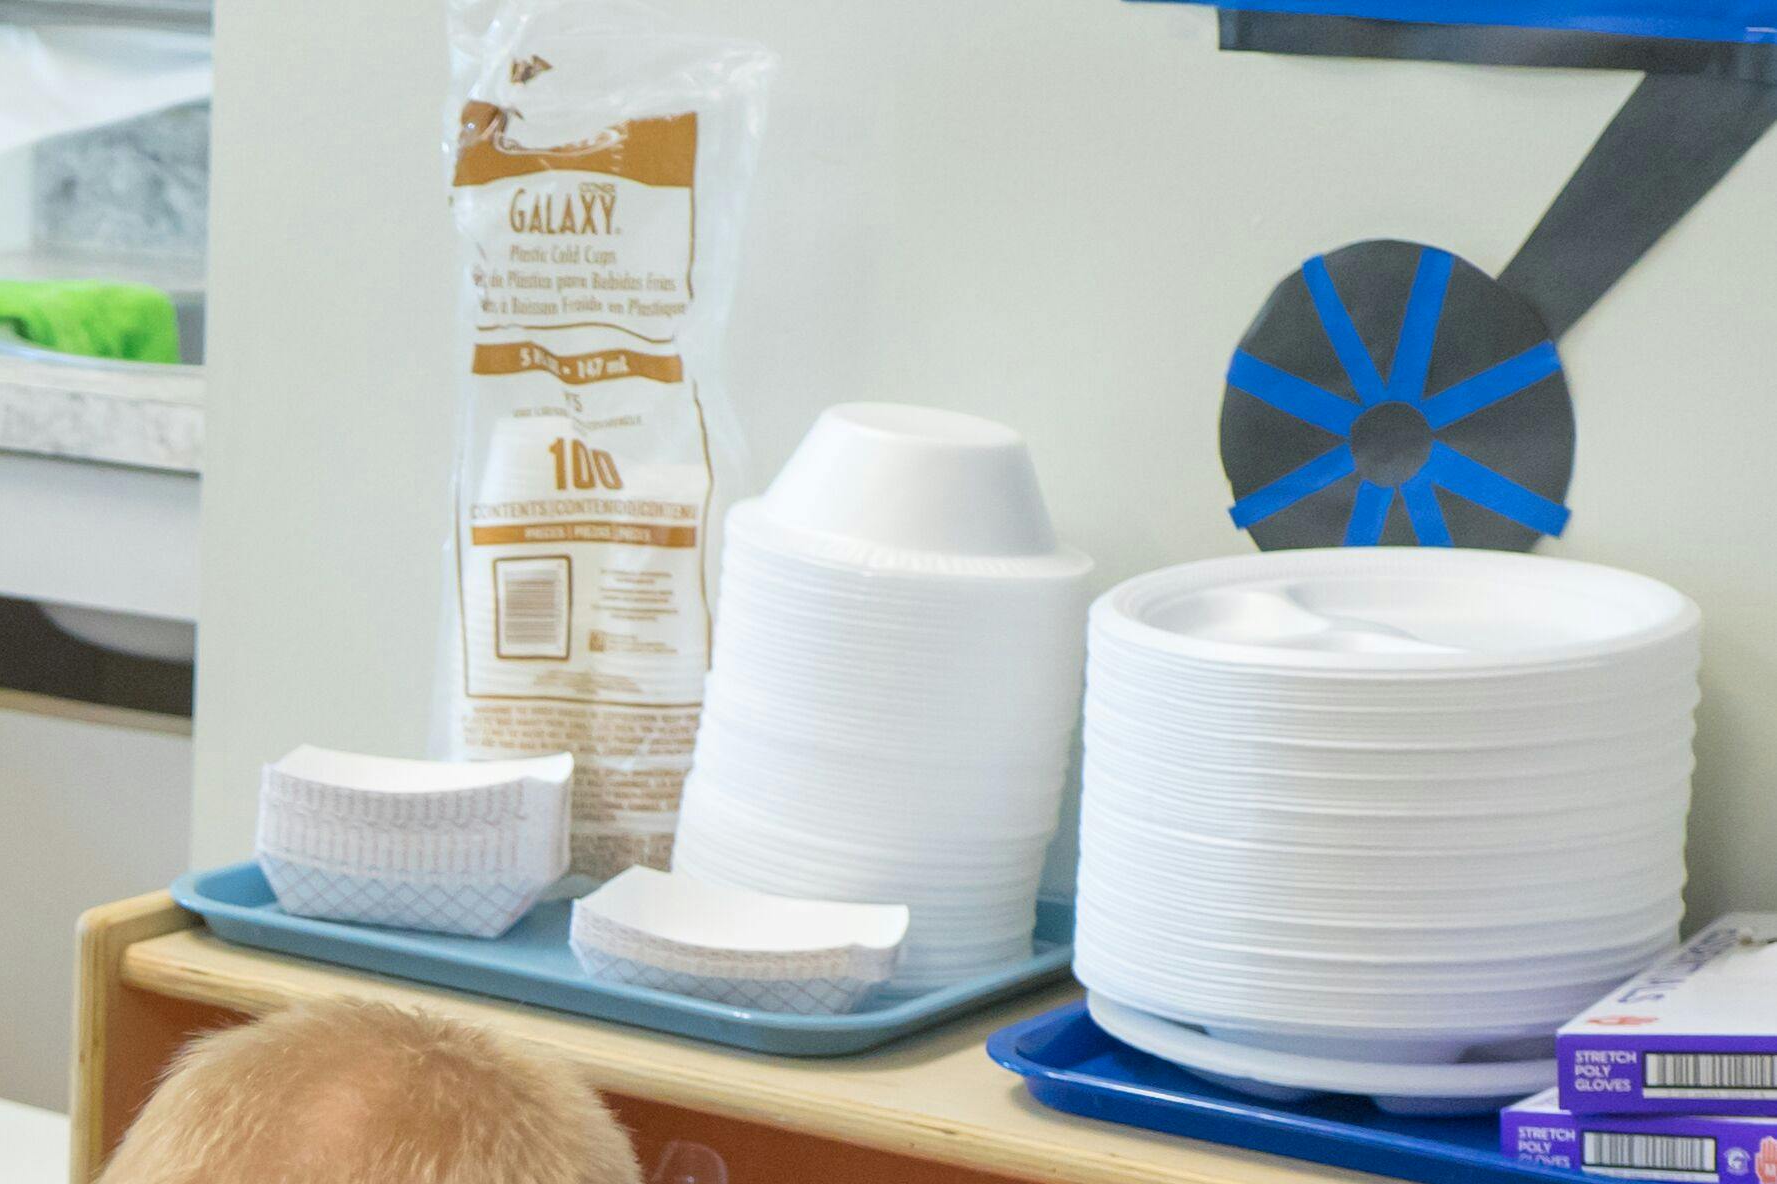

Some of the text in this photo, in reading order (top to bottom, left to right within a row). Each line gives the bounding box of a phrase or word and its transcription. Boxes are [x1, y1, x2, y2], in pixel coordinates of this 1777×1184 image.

[509, 187, 615, 235] GALAXY
[510, 244, 616, 266] Plastic Cold Cups
[549, 437, 623, 490] 100
[1575, 1050, 1637, 1064] STRETCH
[1575, 1065, 1611, 1078] POLY
[1575, 1078, 1631, 1093] GLOVES
[1518, 1126, 1576, 1142] STRETCH
[1518, 1140, 1552, 1154] POLY
